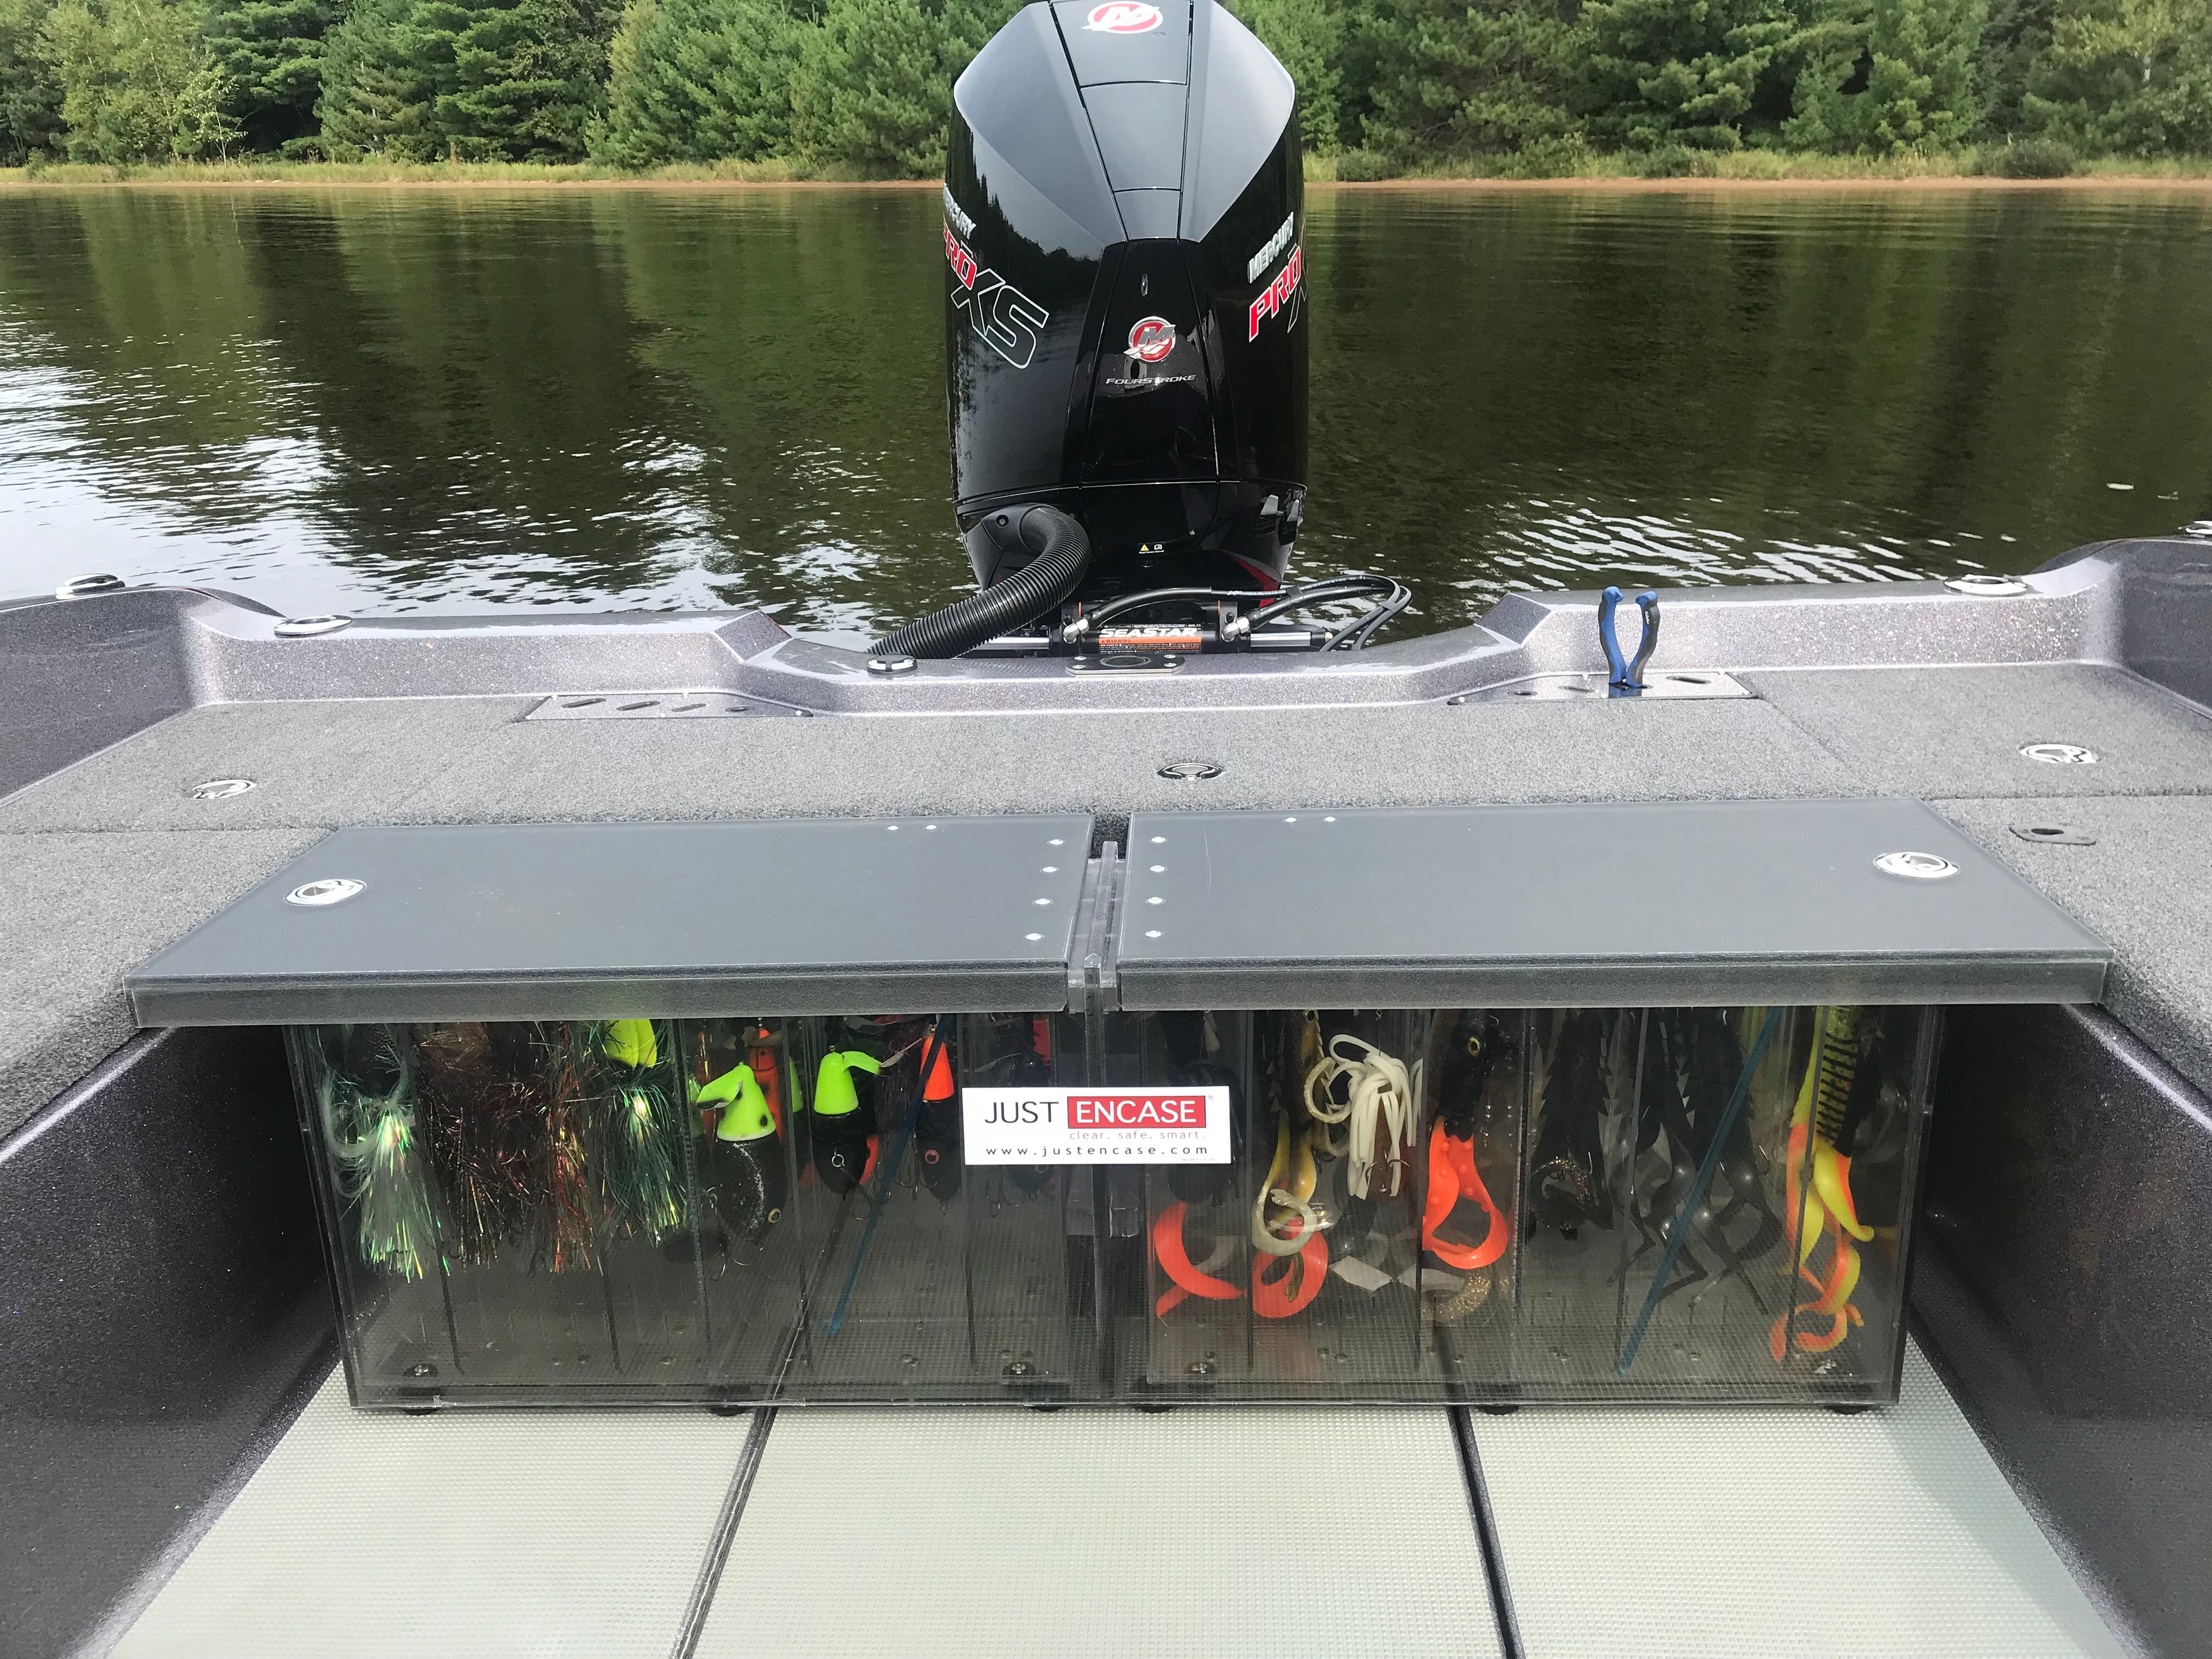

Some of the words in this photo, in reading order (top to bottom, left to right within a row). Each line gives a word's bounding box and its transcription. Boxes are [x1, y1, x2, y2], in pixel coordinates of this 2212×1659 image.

[943, 183, 977, 240] ERCURY
[1247, 211, 1294, 283] MERCURY
[1249, 245, 1301, 343] PRO
[1105, 374, 1196, 385] FOURSTROKE
[1099, 627, 1198, 638] SEASTAR
[984, 1101, 1059, 1123] JUST
[1070, 1130, 1111, 1139] clear.
[1119, 1130, 1152, 1139] safe.
[1160, 1131, 1205, 1139] smart.
[986, 1145, 1207, 1157] www.justencase.com
